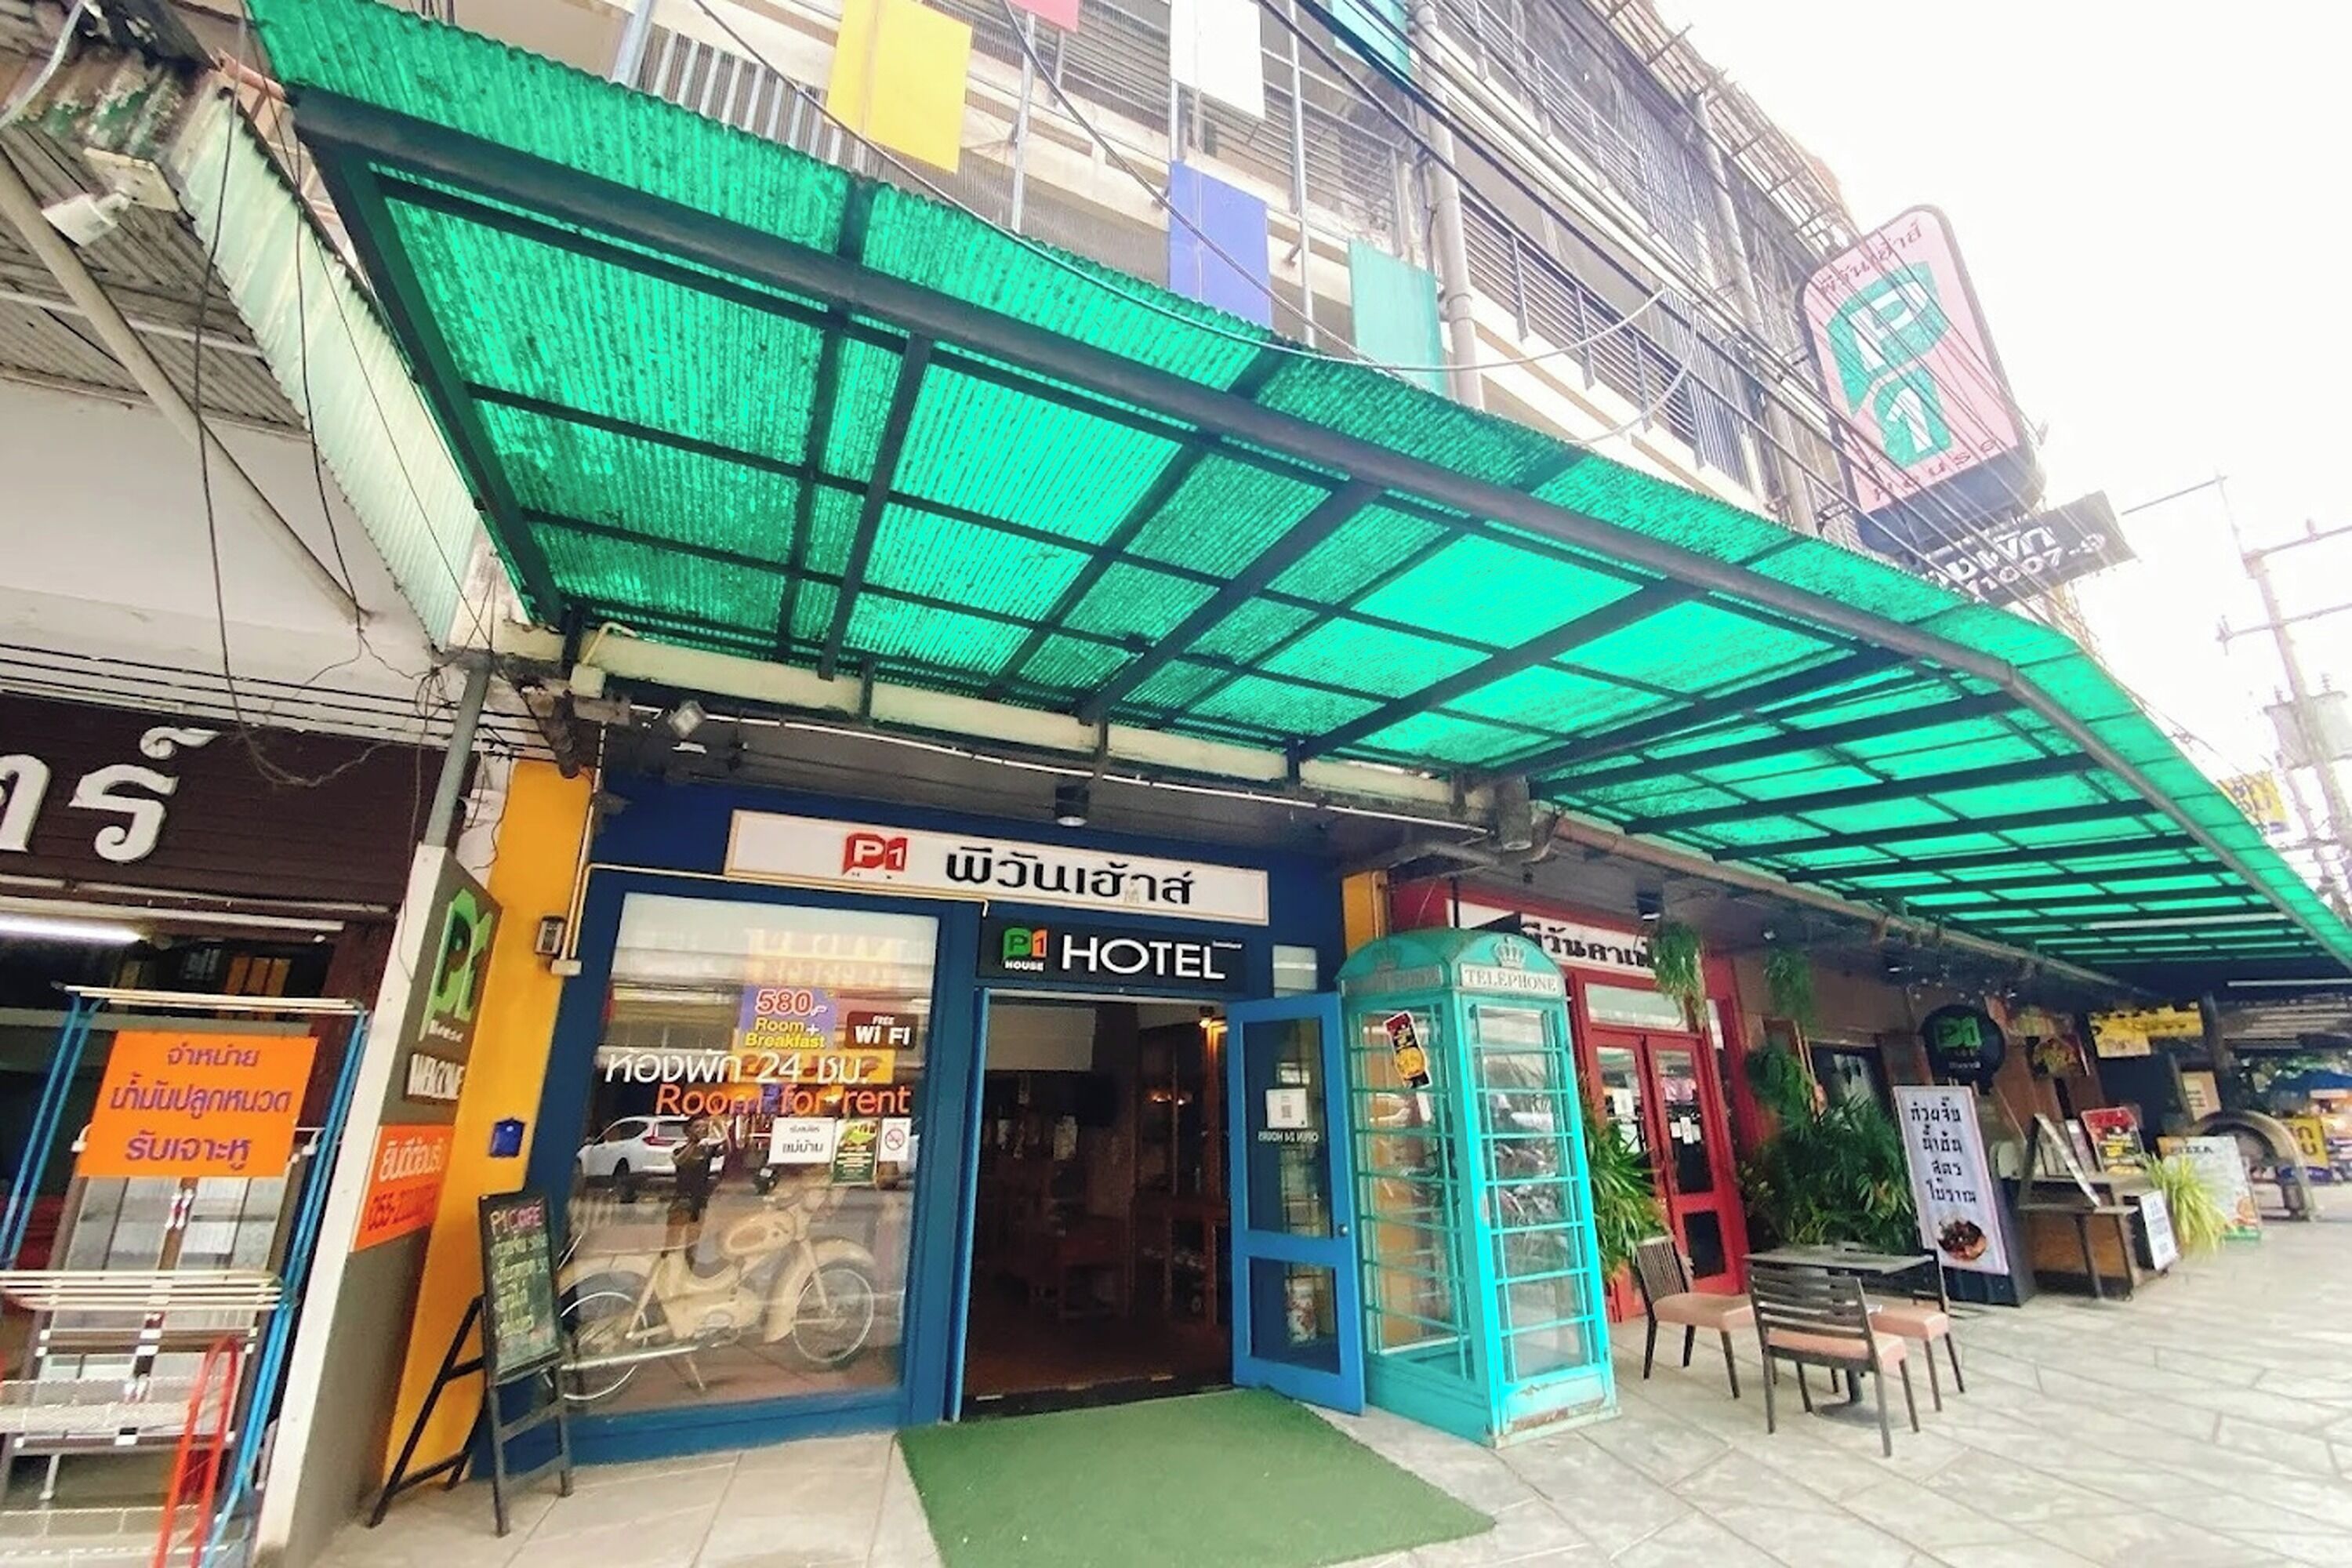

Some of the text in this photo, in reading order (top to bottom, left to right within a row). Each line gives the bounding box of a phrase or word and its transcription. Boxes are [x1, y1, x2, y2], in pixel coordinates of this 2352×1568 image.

[847, 834, 907, 870] P1
[946, 845, 1196, 906] พีวันเฮ้าส์
[1005, 928, 1047, 957] P1
[1062, 934, 1226, 980] HOTEL
[1004, 960, 1044, 971] HOUSE
[1464, 968, 1556, 992] TELEPHONE
[745, 1032, 826, 1049] Breakfast
[755, 1017, 804, 1033] Room
[167, 1042, 261, 1067] จำหน่าย
[604, 1046, 742, 1083] ห้องพัก
[757, 1051, 804, 1083] 24
[110, 1071, 292, 1120] น้ำมันปลูกหนวด
[655, 1083, 911, 1115] Room for rent
[125, 1129, 252, 1171] รับเจาะหู
